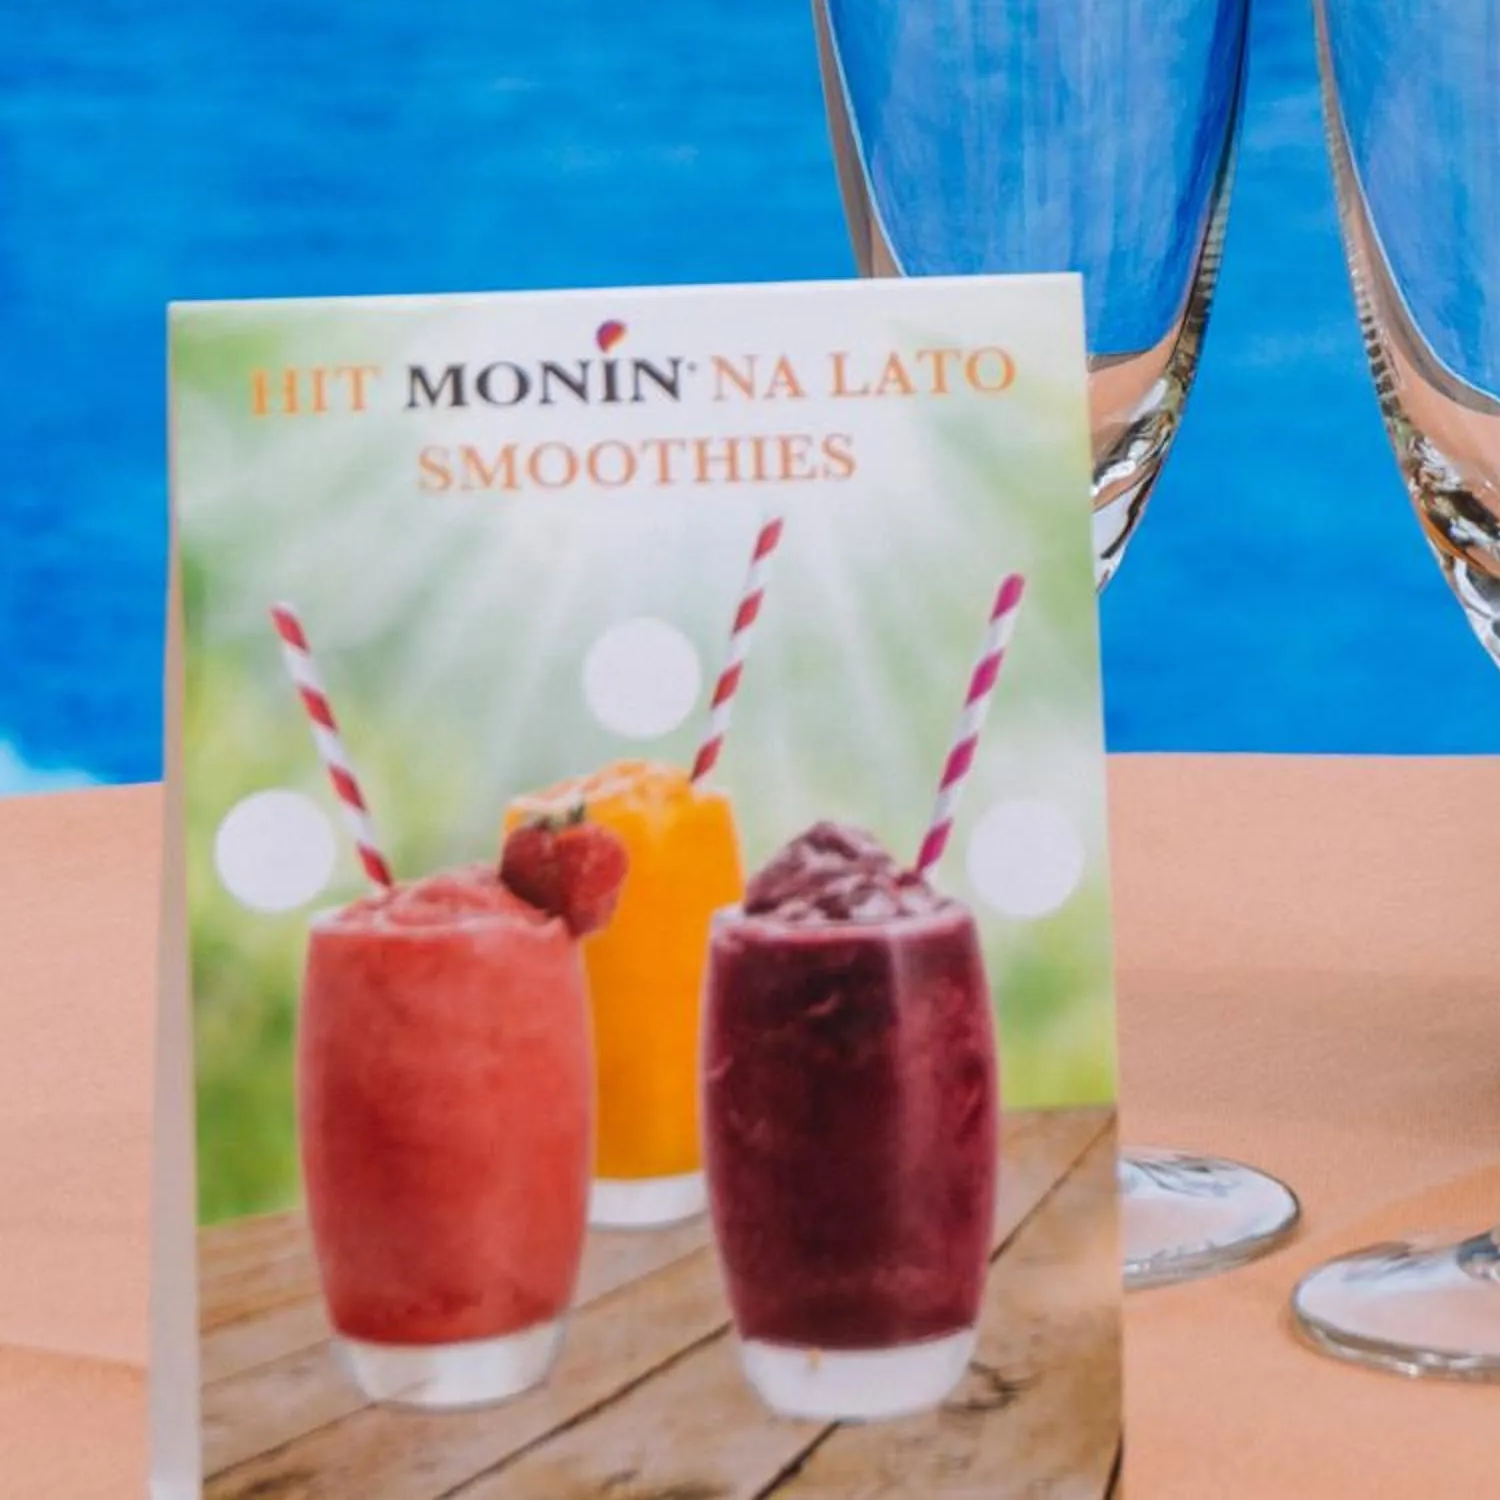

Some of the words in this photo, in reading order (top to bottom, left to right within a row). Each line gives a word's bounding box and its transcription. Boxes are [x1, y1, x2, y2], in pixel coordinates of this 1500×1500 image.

[250, 364, 379, 416] HIT
[711, 353, 807, 401] NA
[829, 346, 1016, 399] LATO
[417, 432, 858, 493] SMOOTHIES
